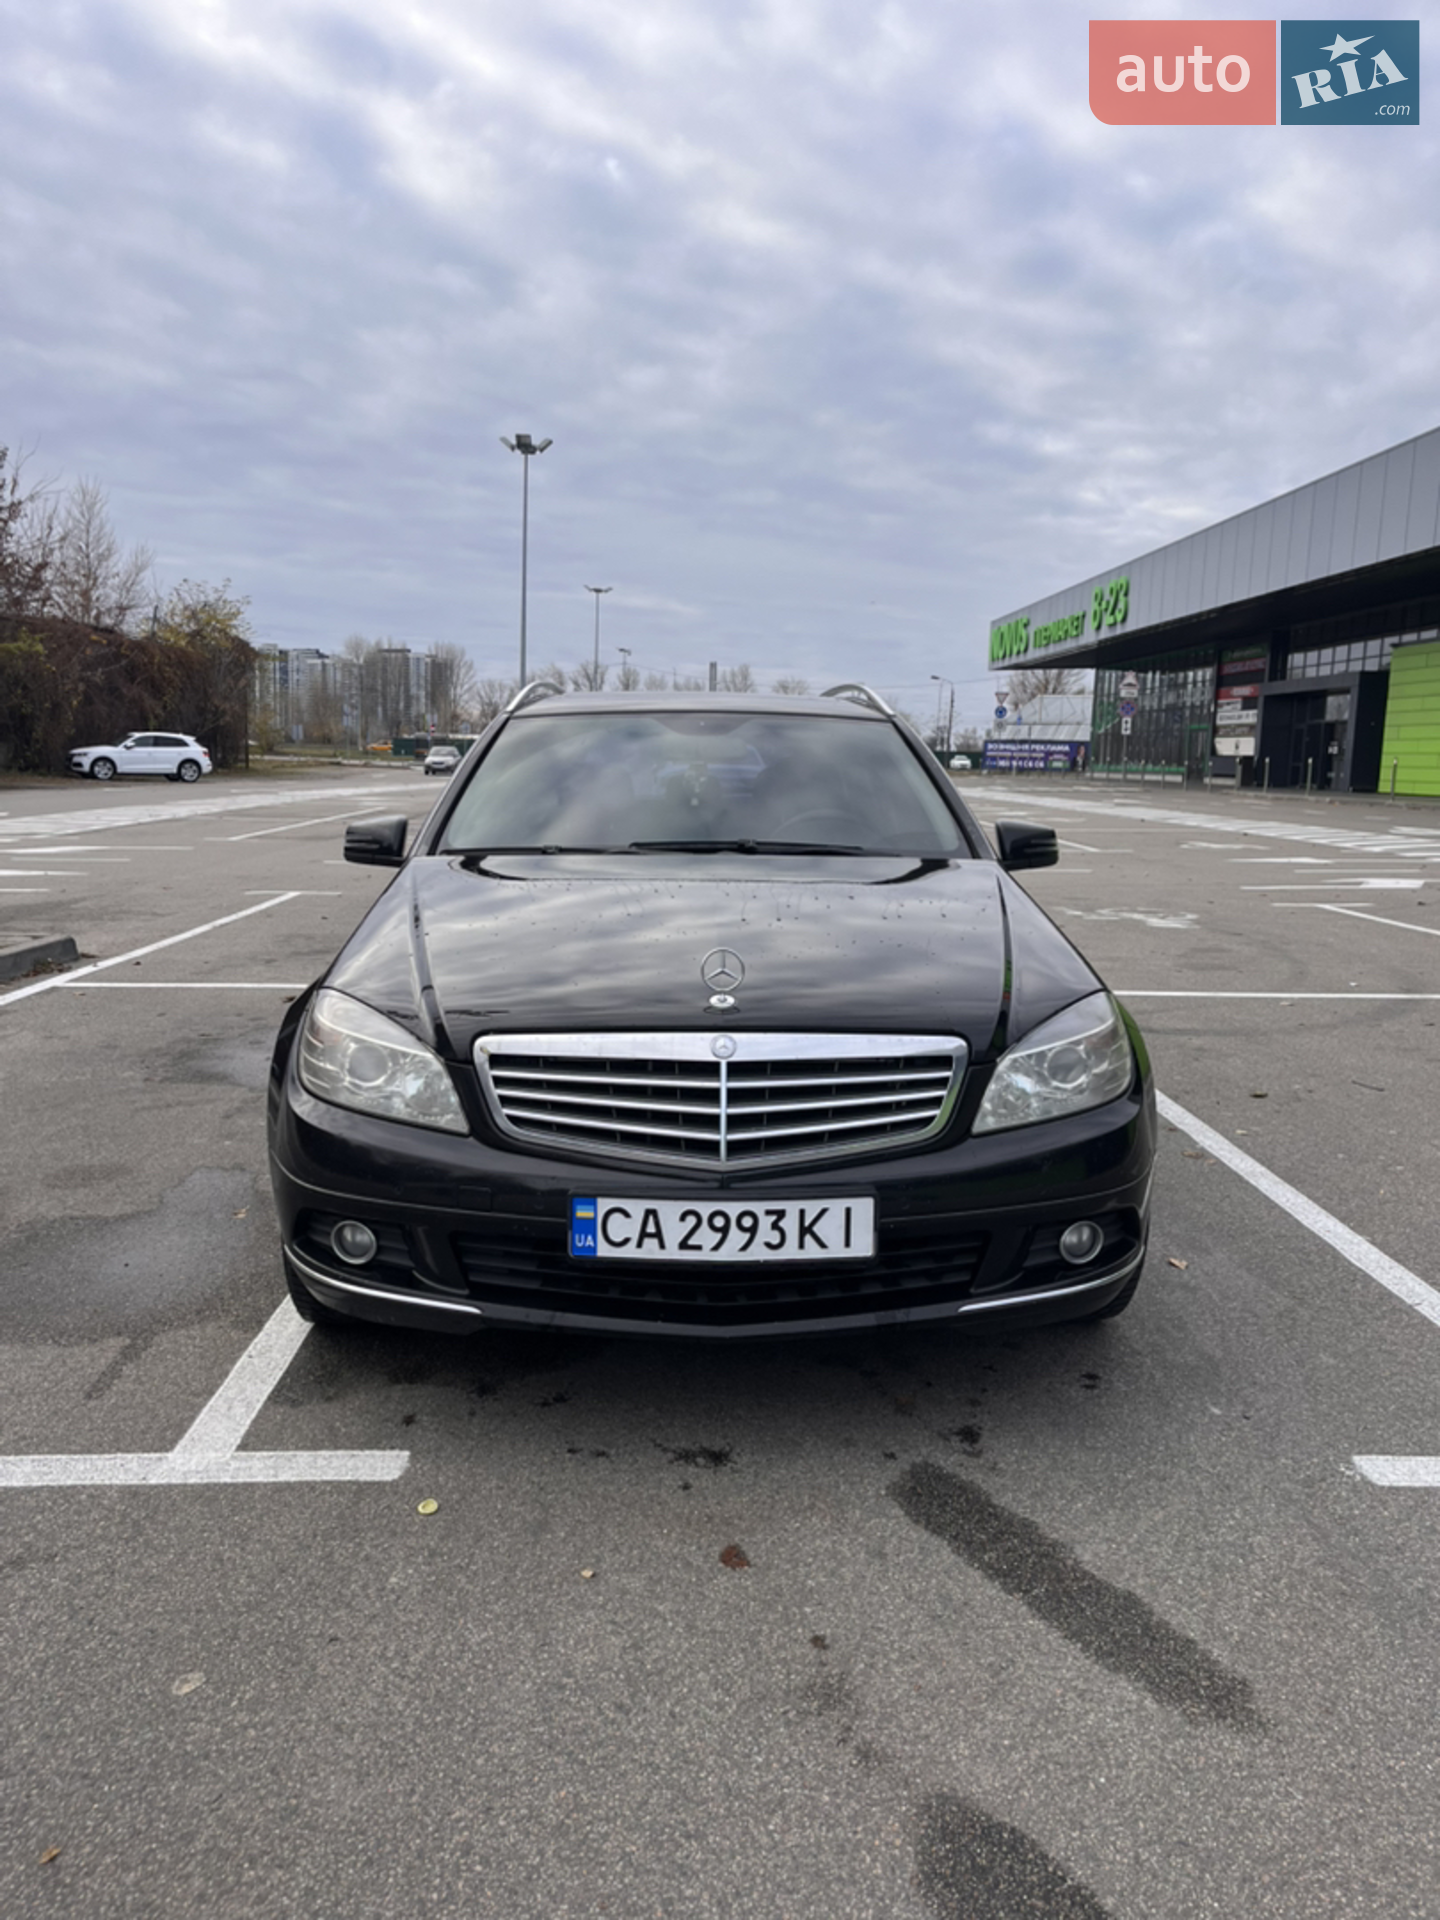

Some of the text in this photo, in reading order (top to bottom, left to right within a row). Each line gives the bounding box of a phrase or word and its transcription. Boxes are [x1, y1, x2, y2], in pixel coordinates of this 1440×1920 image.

[990, 617, 1029, 661] NOVUS
[1030, 743, 1070, 752] РЕКЛАМА
[575, 1234, 595, 1248] UA
